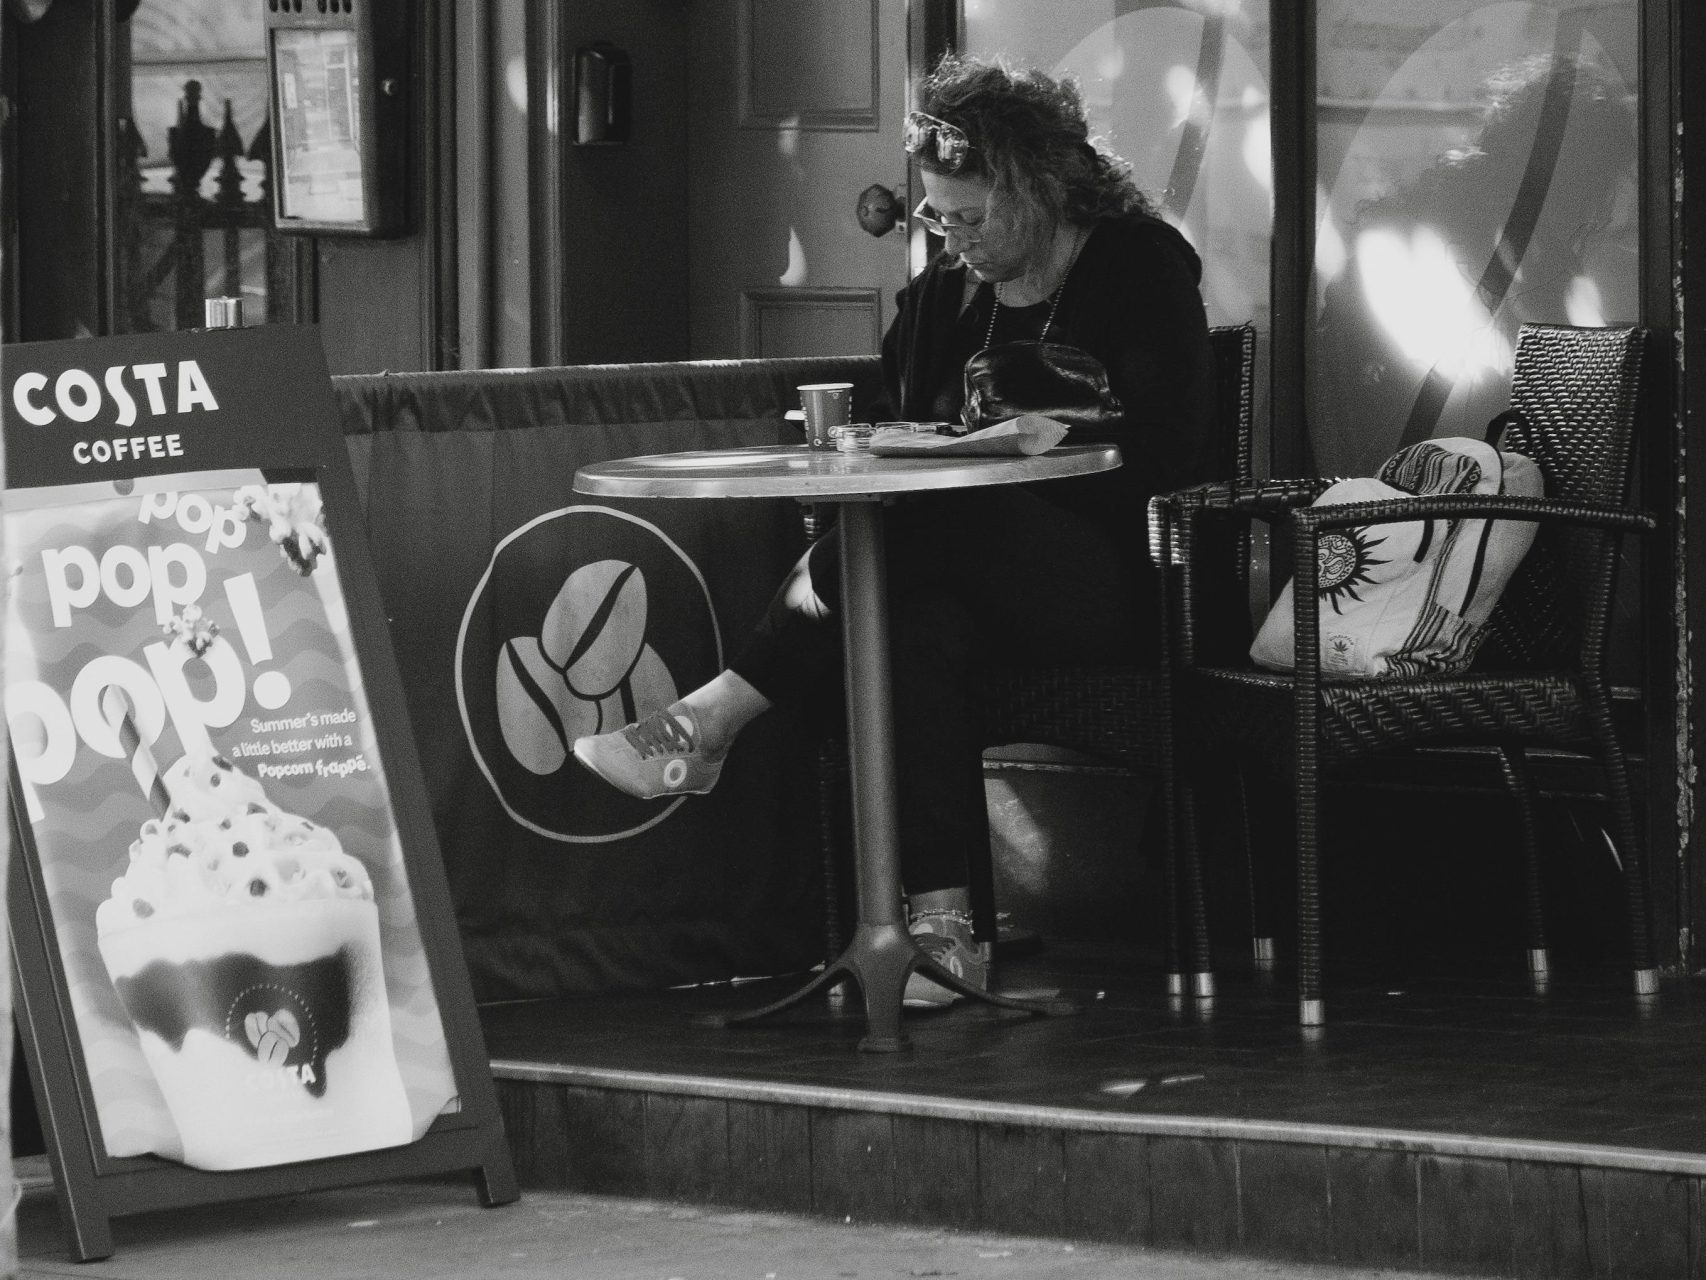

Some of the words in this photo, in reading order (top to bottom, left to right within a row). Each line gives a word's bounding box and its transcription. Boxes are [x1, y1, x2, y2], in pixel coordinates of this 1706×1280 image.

[13, 360, 220, 428] COSTA
[72, 434, 184, 465] COFFEE
[138, 488, 247, 554] pop
[42, 542, 207, 628] pop
[251, 712, 319, 734] Summer's
[320, 708, 357, 724] made
[231, 746, 242, 757] a
[241, 740, 271, 757] little
[270, 739, 313, 755] better
[314, 732, 343, 750] with
[343, 735, 353, 747] a
[257, 761, 314, 780] Popcorn
